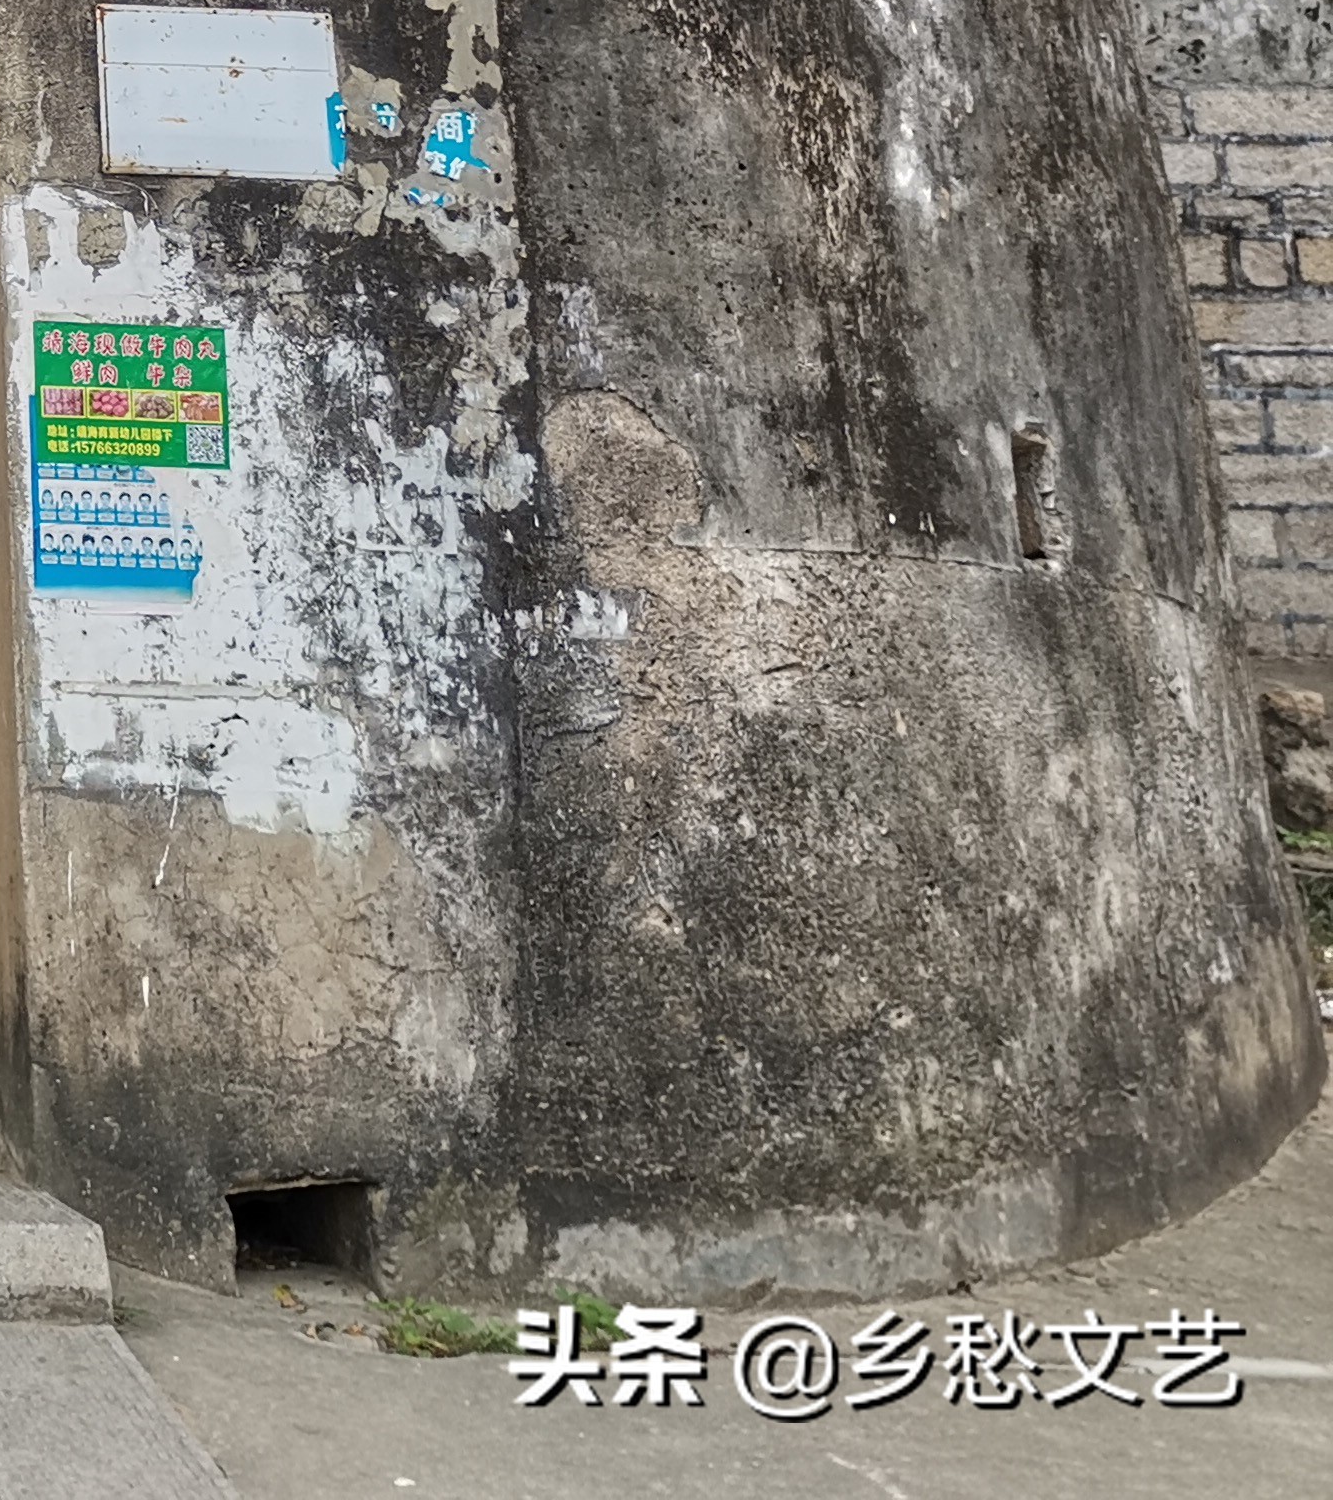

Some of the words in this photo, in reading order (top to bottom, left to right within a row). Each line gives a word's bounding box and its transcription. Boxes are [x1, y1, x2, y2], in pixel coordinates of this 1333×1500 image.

[42, 329, 221, 361] 靖海现做牛肉丸
[71, 359, 119, 386] 鲜肉
[146, 364, 194, 388] 牛杂
